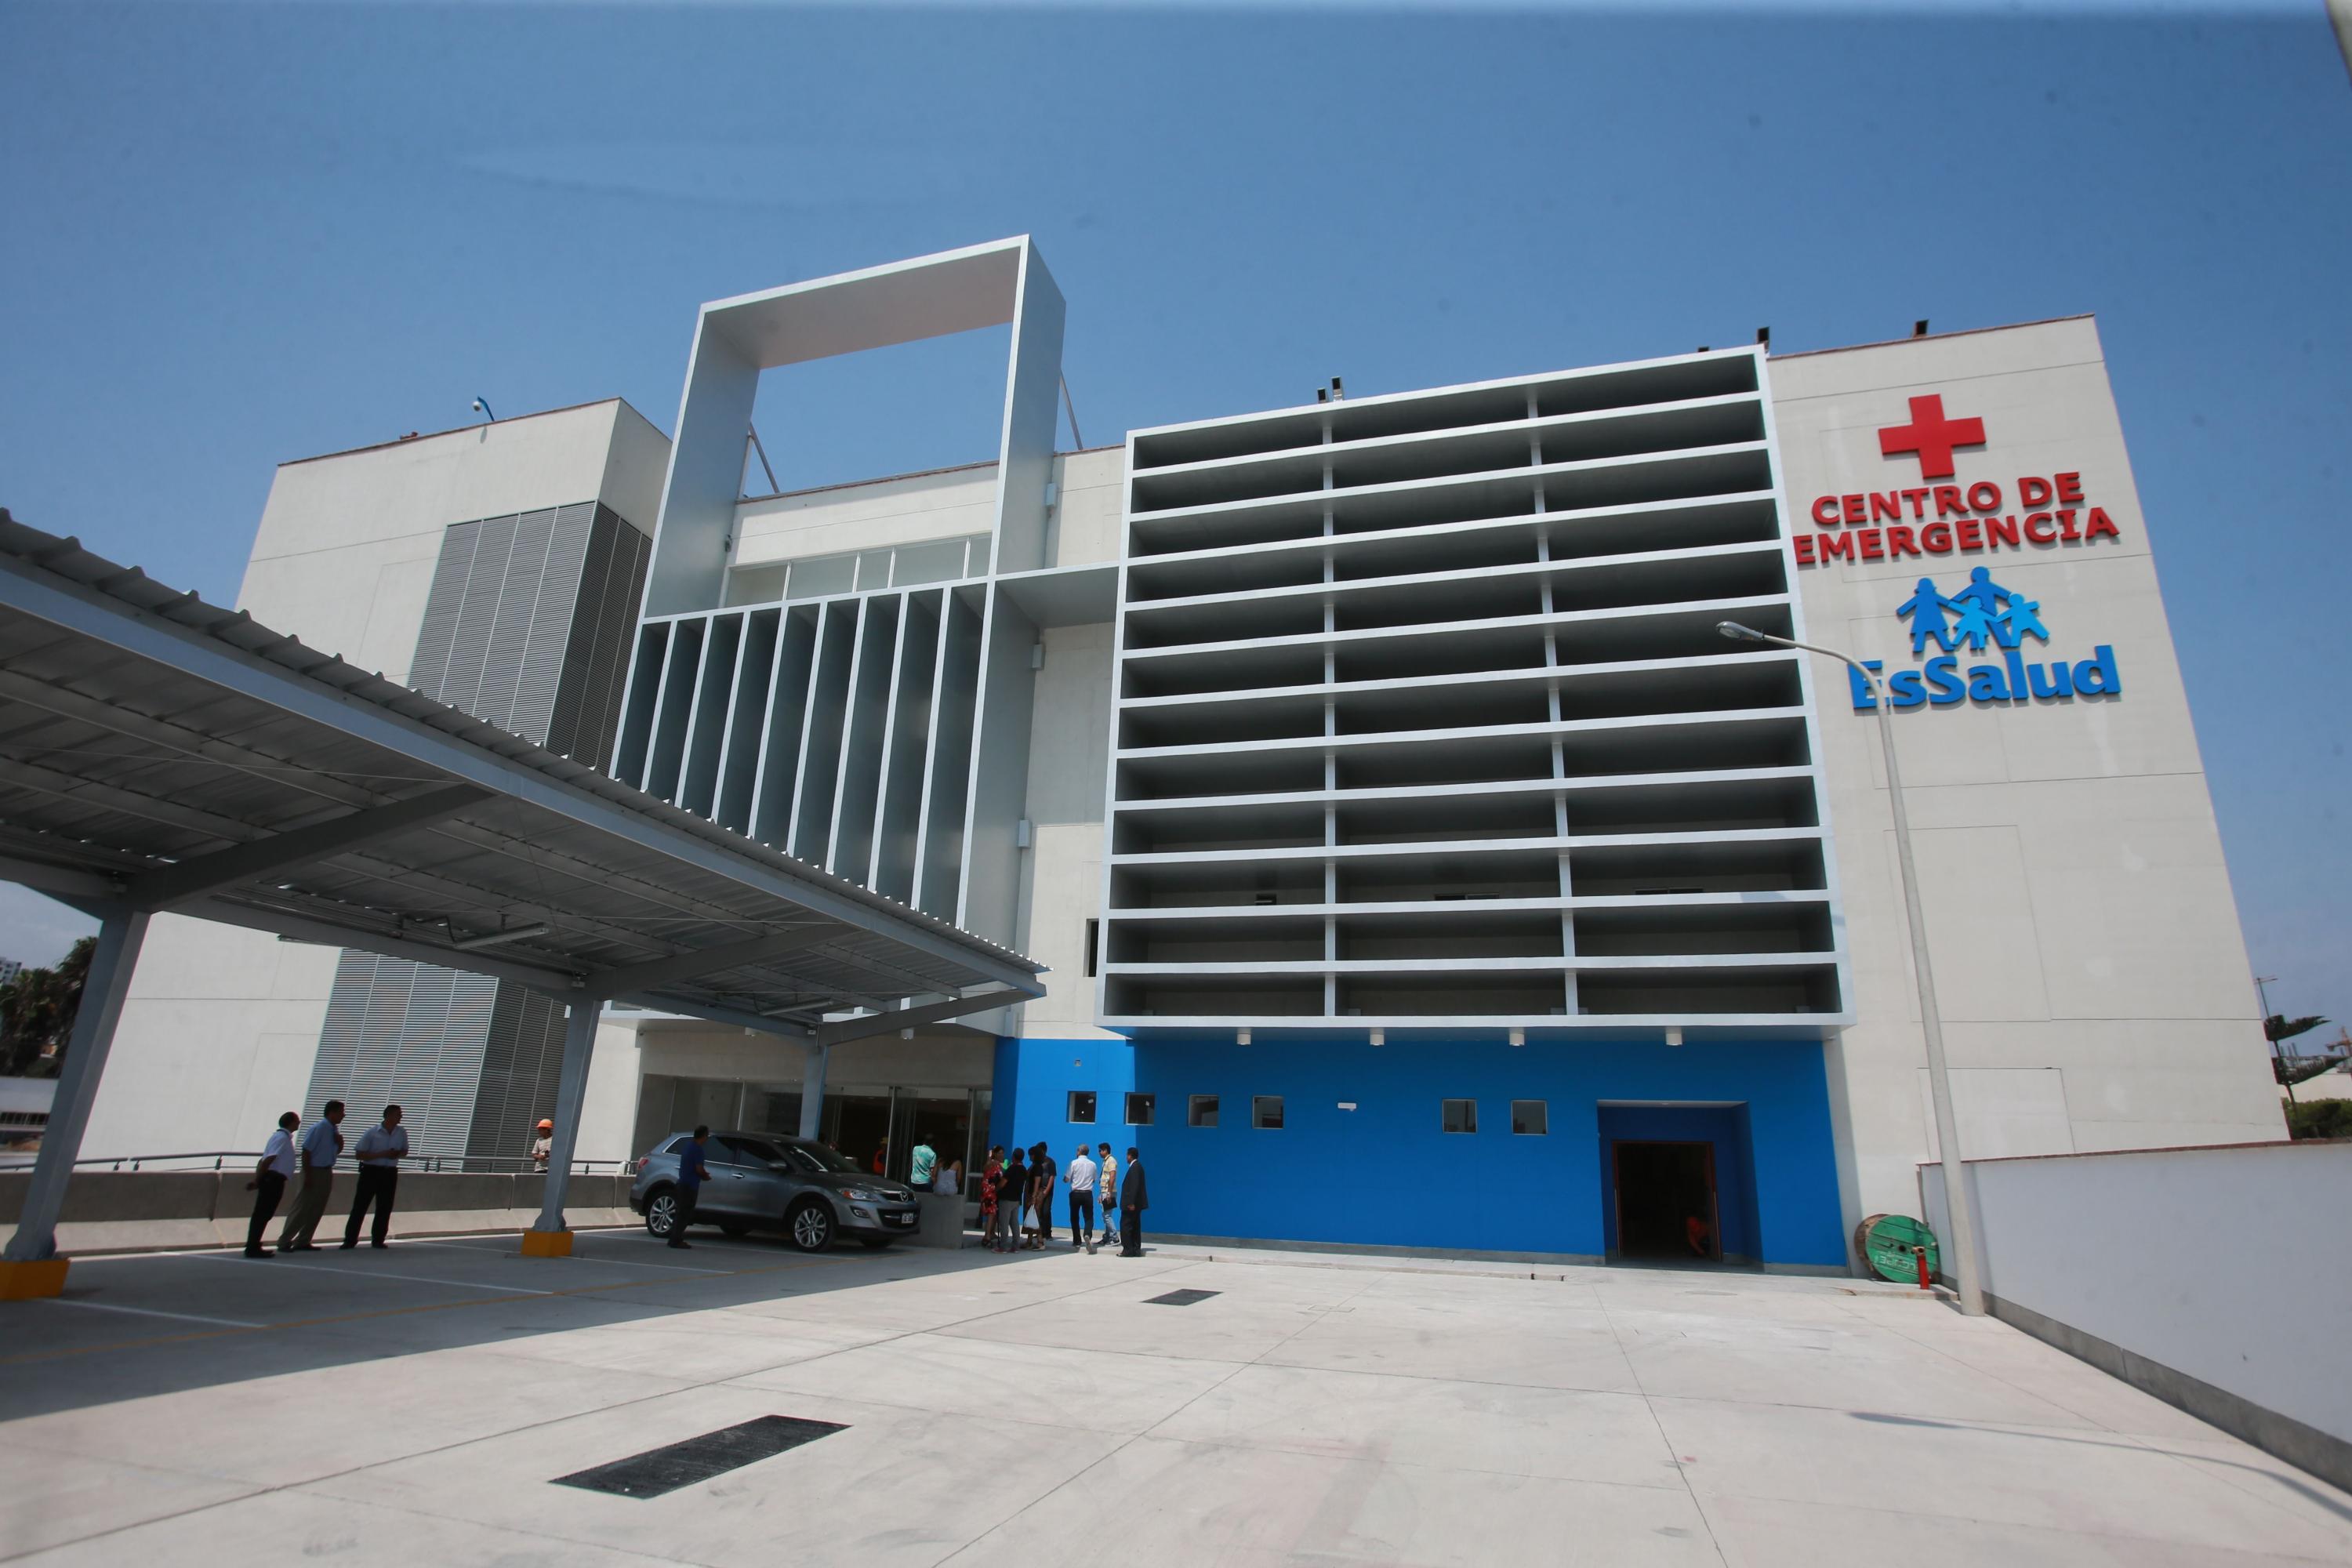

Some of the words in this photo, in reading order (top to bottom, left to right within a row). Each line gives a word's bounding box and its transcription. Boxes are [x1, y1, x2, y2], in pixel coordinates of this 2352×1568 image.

[1812, 481, 2002, 524] CENTRO
[2017, 472, 2084, 507] DE
[1793, 506, 2119, 564] EMERGENCIA
[1848, 645, 2122, 709] EsSalud
